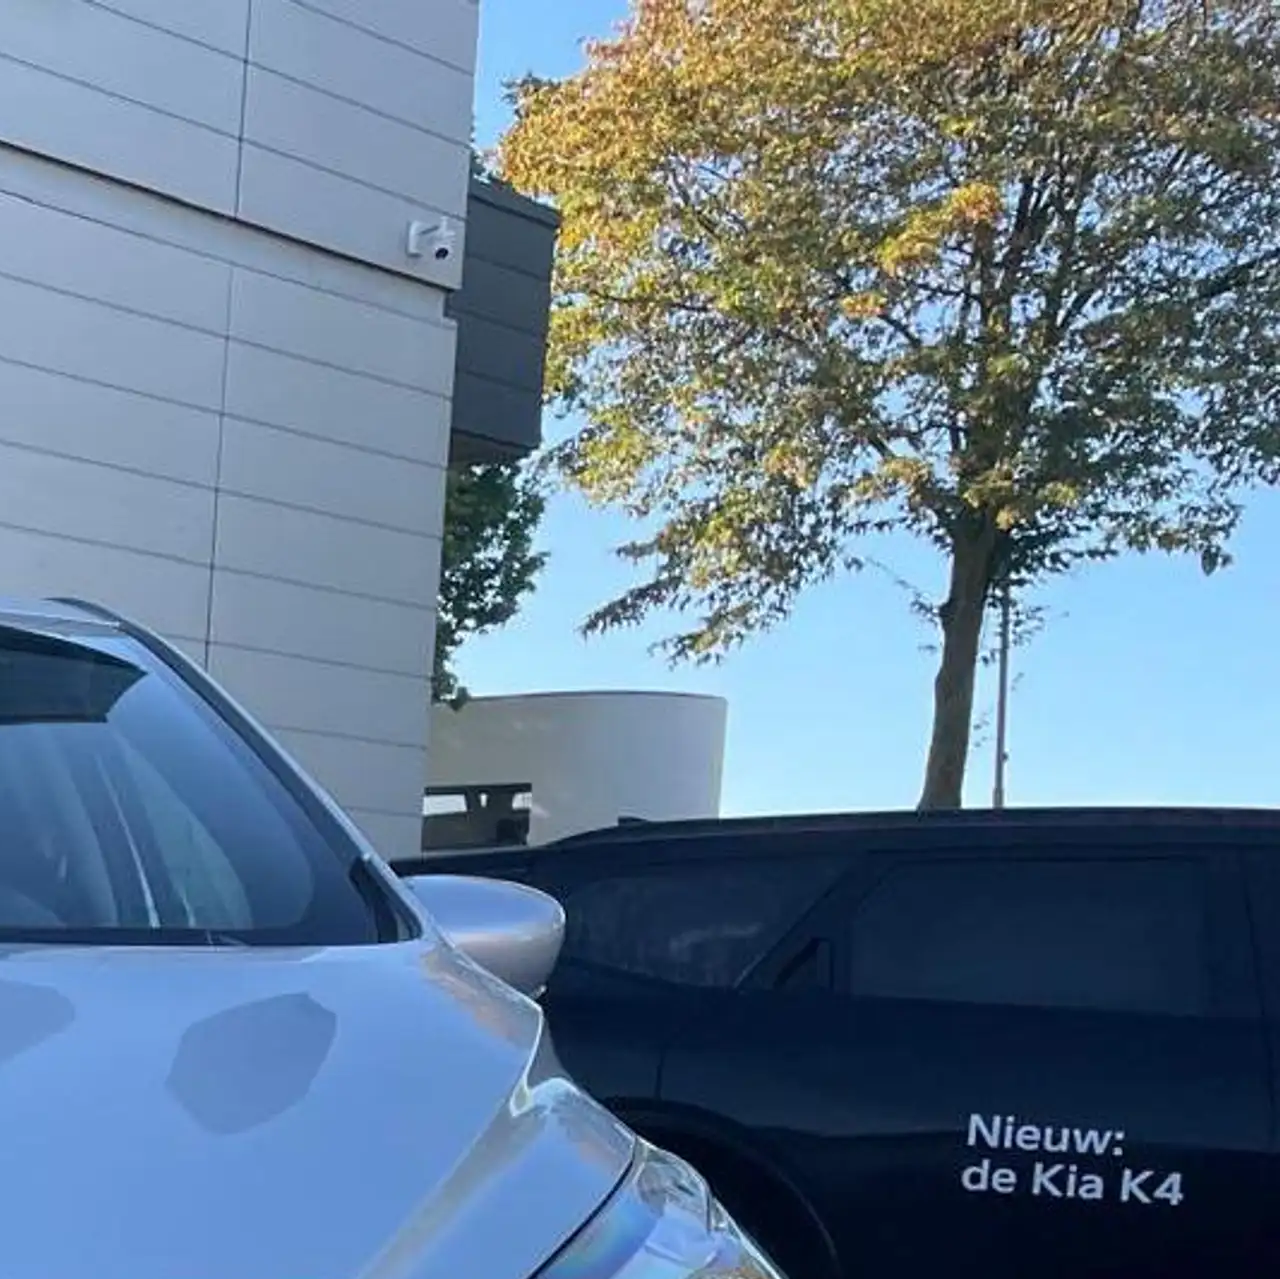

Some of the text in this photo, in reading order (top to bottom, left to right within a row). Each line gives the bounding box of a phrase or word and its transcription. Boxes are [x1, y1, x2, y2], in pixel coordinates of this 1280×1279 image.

[967, 1113, 1125, 1156] Nieuw:
[961, 1159, 1184, 1206] de Kia K4
